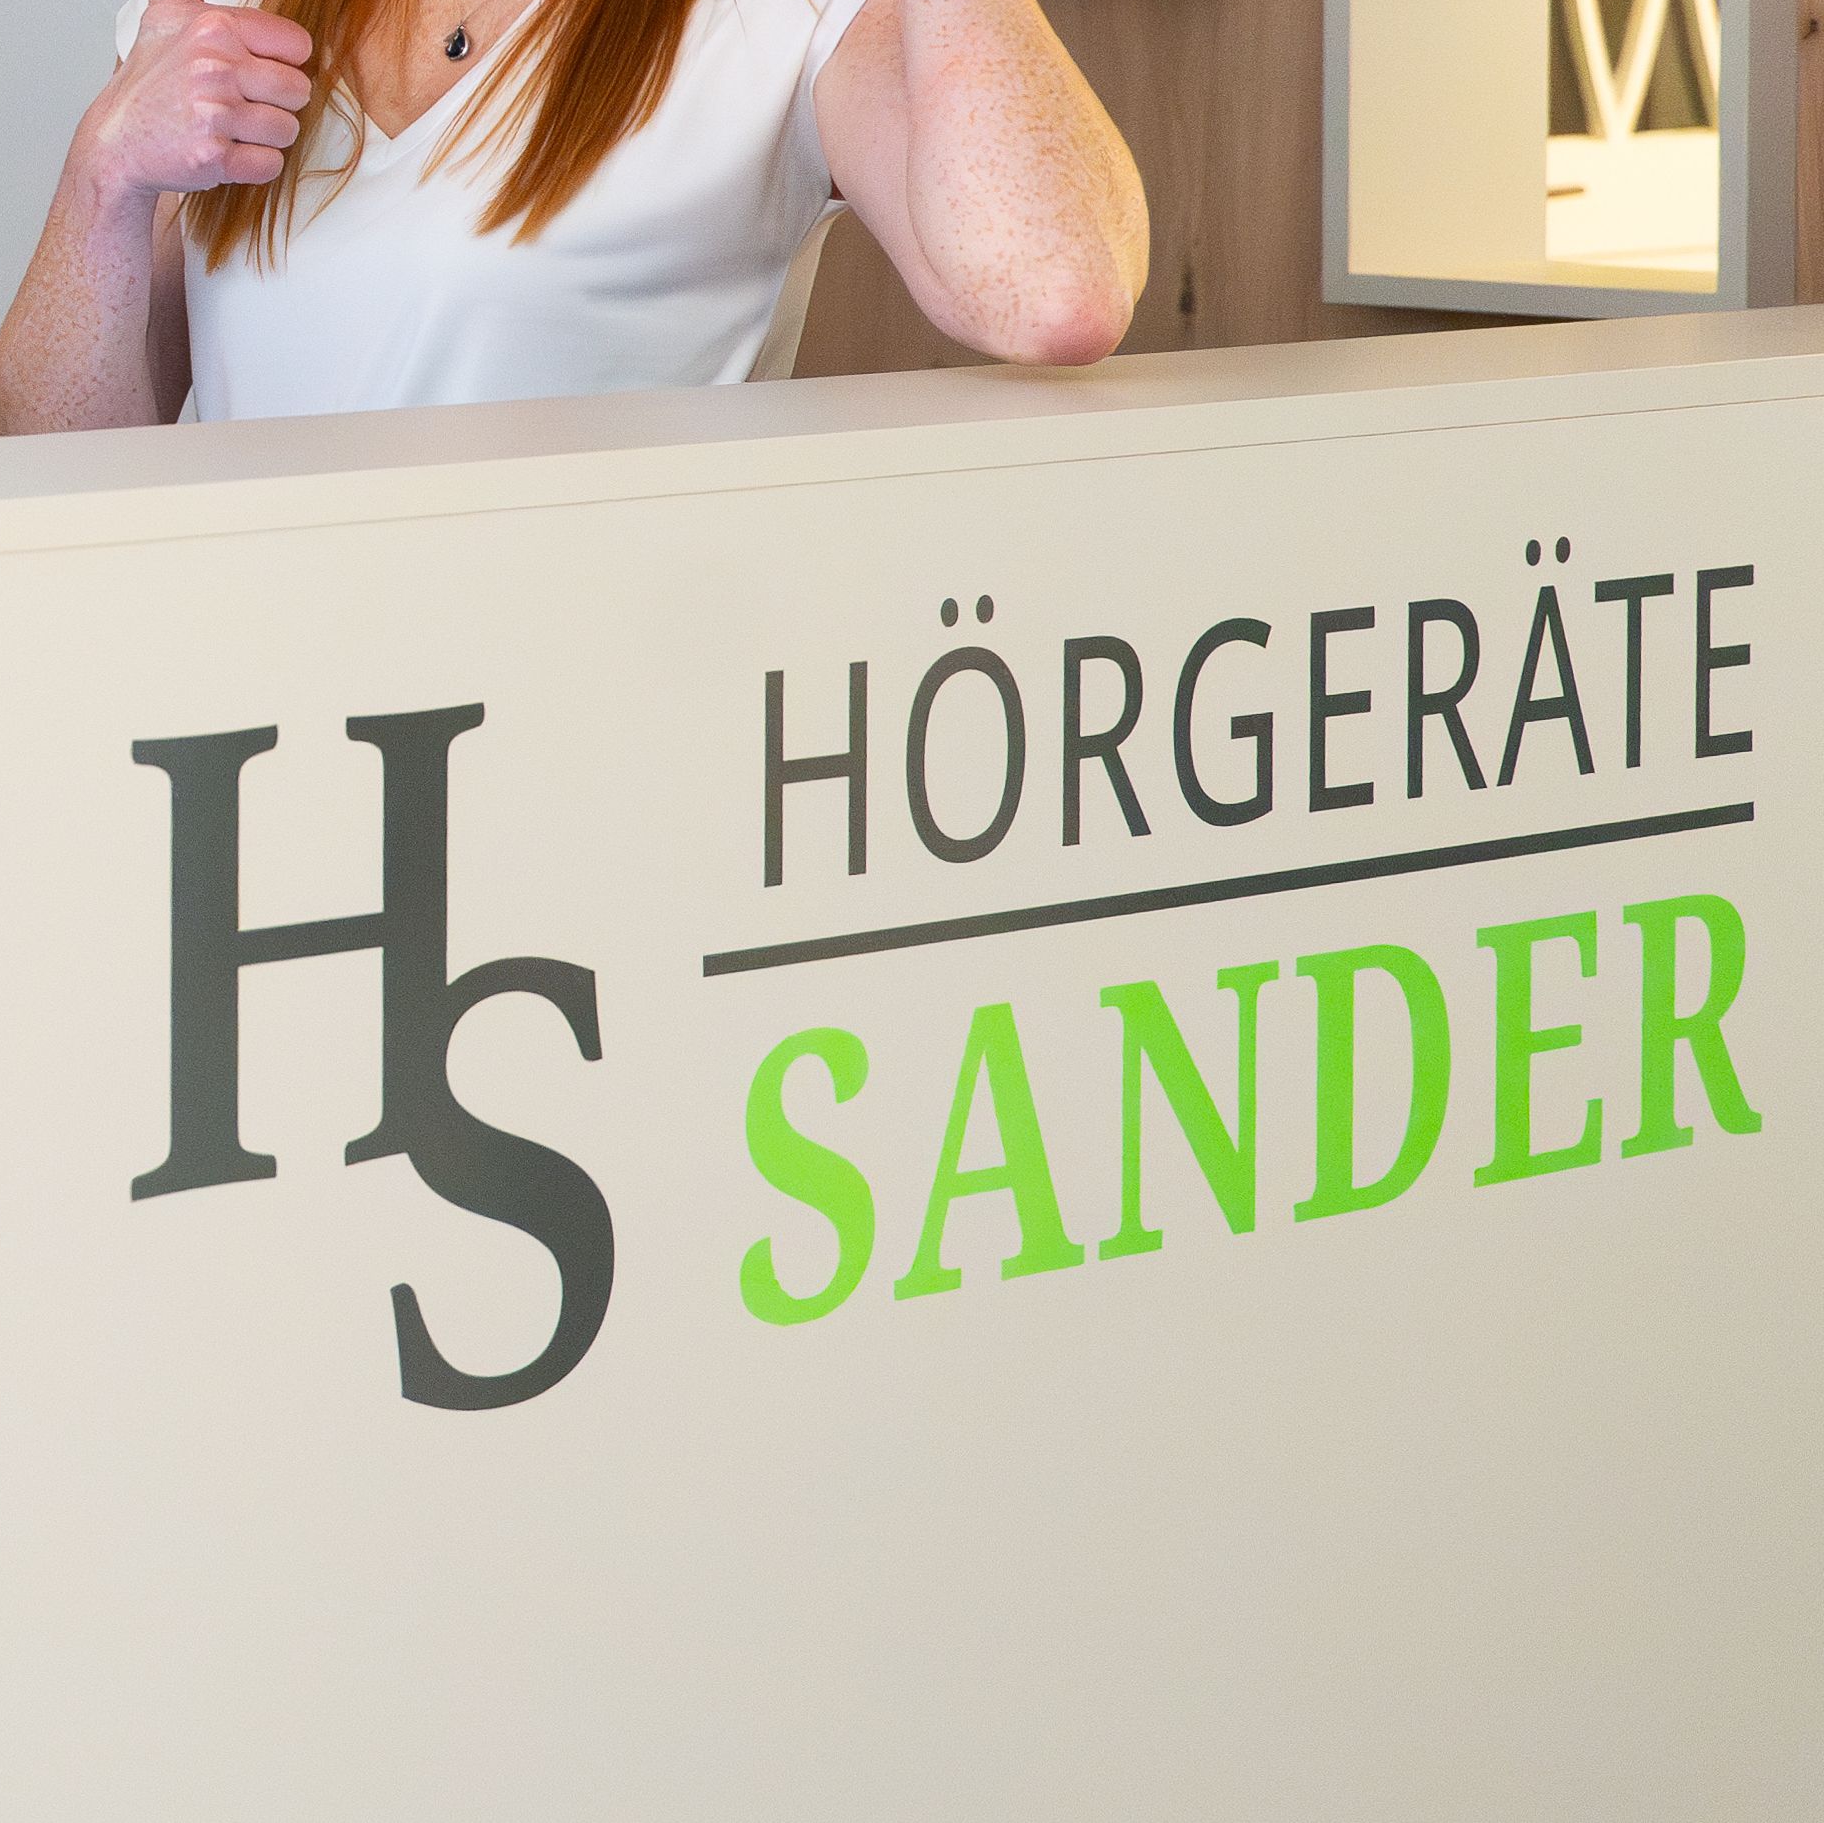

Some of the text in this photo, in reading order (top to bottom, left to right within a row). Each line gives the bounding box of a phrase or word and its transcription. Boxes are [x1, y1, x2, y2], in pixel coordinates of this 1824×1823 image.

[764, 537, 1754, 887] HÖRGERÄTE
[132, 703, 614, 1411] HS
[740, 894, 1762, 1326] SANDER
